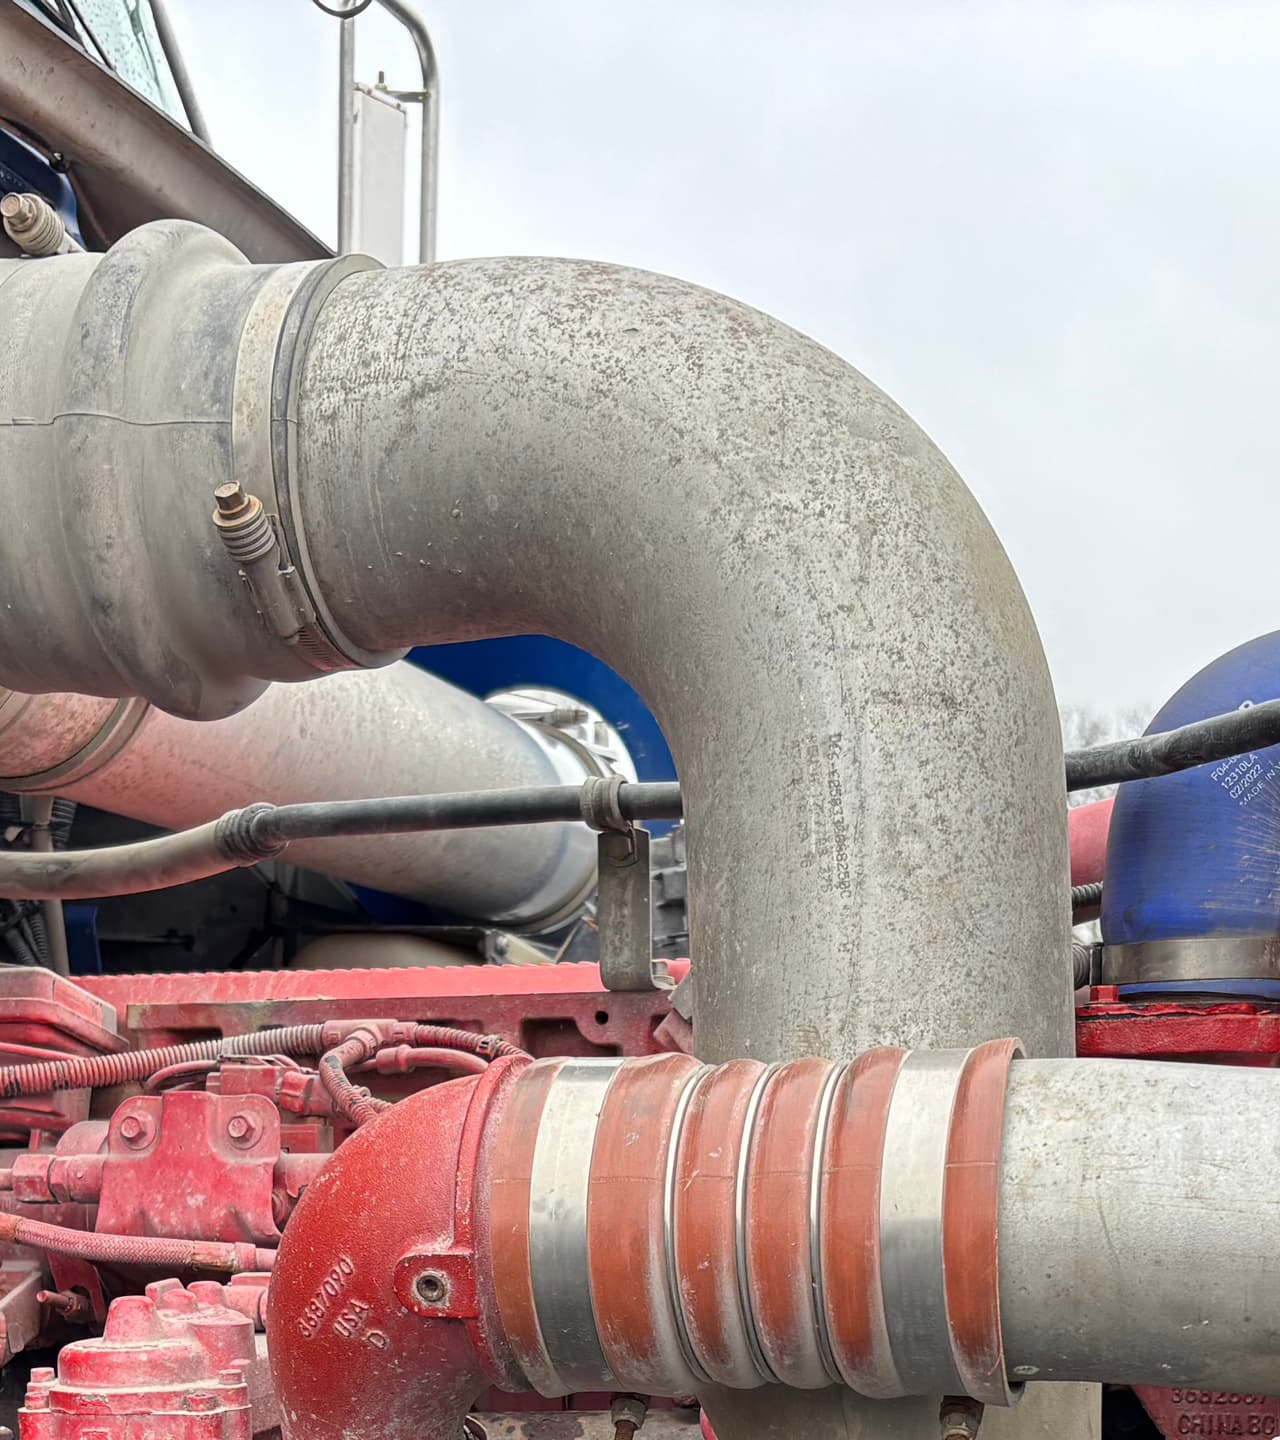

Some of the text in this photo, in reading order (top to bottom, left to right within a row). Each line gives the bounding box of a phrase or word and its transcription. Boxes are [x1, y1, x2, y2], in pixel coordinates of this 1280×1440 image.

[1221, 753, 1259, 789] 12310LA
[1229, 763, 1264, 800] 02/2022
[298, 1254, 355, 1338] 3687090
[333, 1299, 369, 1338] USA
[366, 1330, 387, 1350] D
